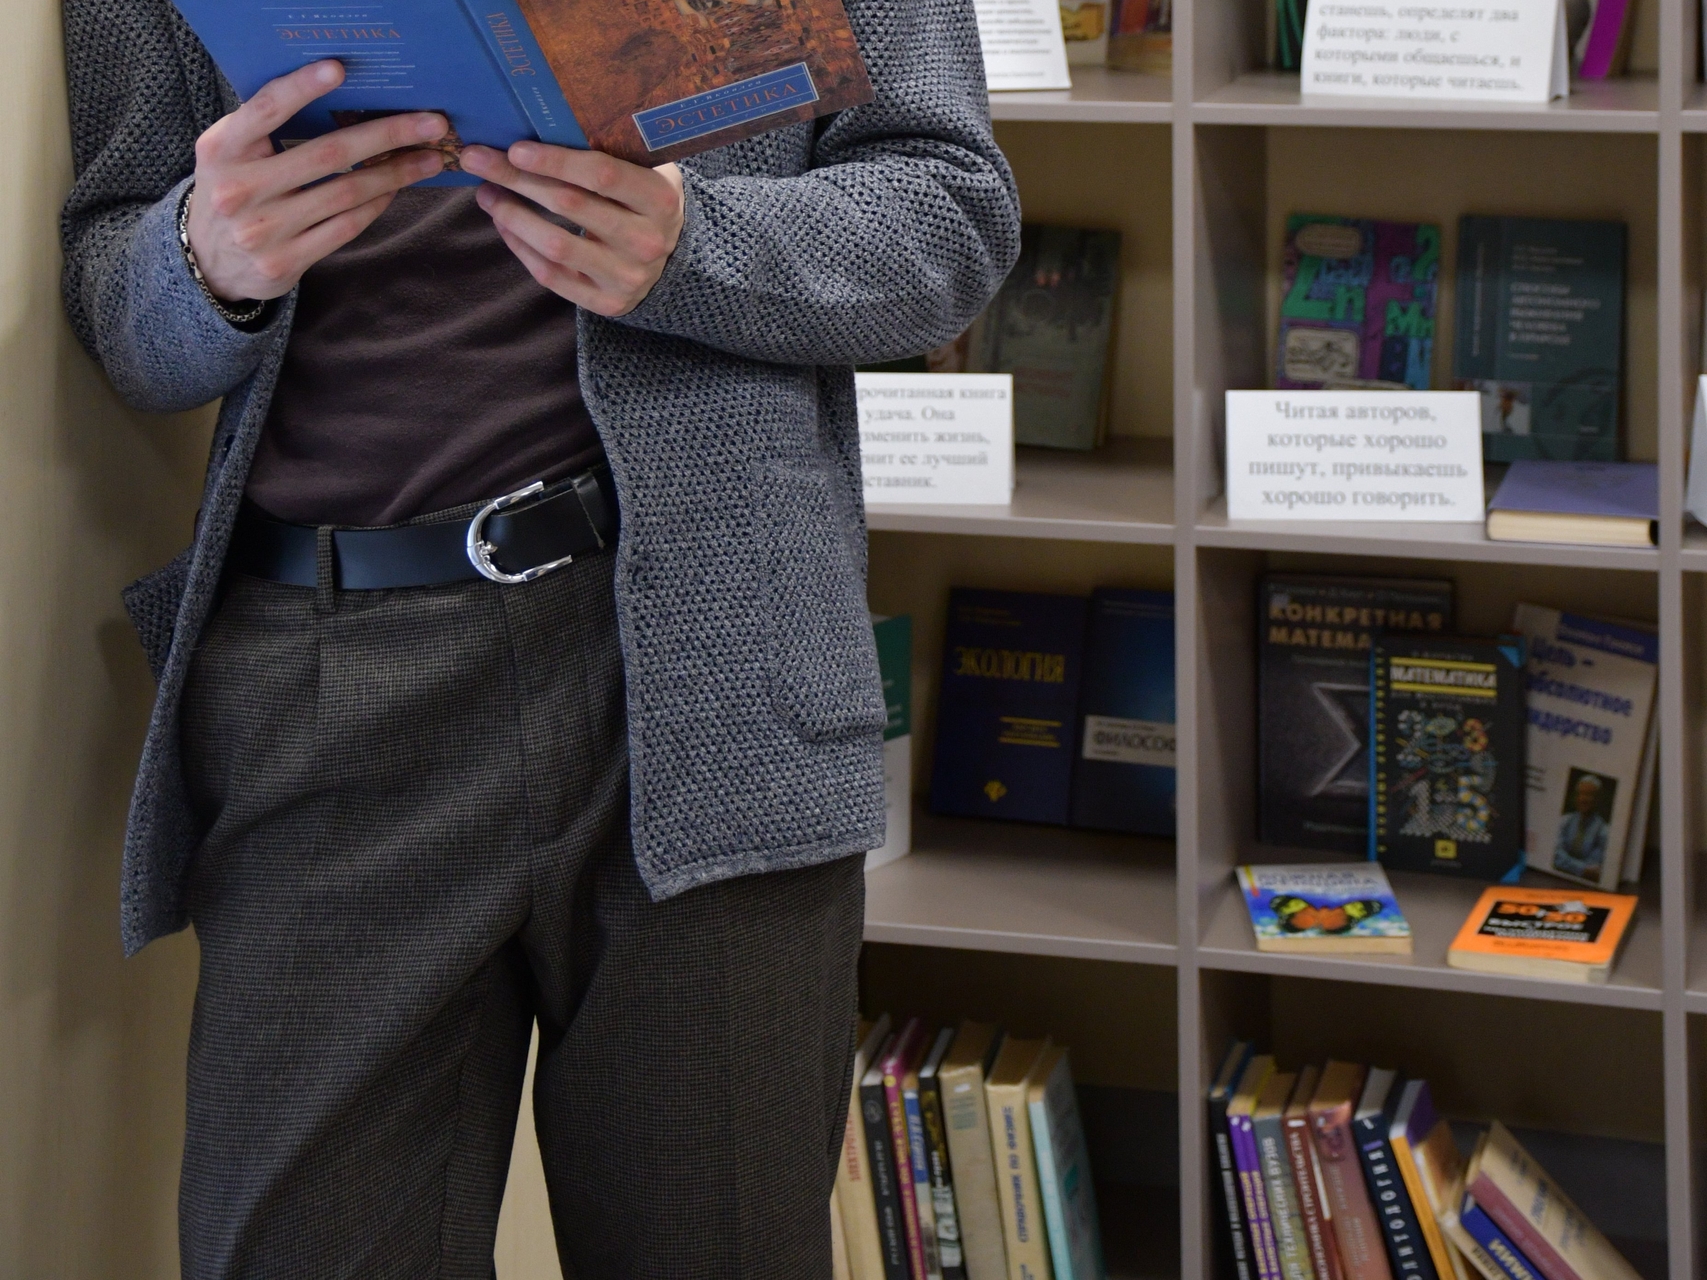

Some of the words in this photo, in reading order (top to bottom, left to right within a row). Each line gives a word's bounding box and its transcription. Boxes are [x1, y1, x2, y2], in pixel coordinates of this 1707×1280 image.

[1319, 5, 1393, 19] станешь,
[1398, 7, 1484, 21] определят
[1488, 10, 1519, 23] два
[276, 27, 402, 41] ЭСТЕТИКА
[1450, 31, 1460, 42] с
[486, 12, 536, 78] ЭСТЕТИКА
[1314, 49, 1398, 65] которыми
[1403, 48, 1505, 67] общаешься,
[1509, 55, 1521, 68] и
[1372, 73, 1442, 90] которые
[655, 82, 799, 135] ЭСТЕТИКА
[857, 387, 954, 402] рочитанная
[959, 388, 1007, 400] книга
[865, 408, 915, 424] удача.
[921, 406, 956, 421] Она
[1275, 401, 1339, 419] Читая
[1345, 404, 1437, 424] авторов,
[859, 431, 930, 443] зменить
[934, 431, 991, 445] жизнь,
[1267, 432, 1357, 452] которые
[1363, 433, 1448, 453] хорошо
[861, 453, 894, 465] нит
[921, 450, 989, 468] лучший
[1248, 460, 1326, 480] пишут,
[1332, 461, 1468, 481] привыкаешь
[1262, 489, 1347, 509] хорошо
[1352, 490, 1456, 510] говорить.
[1268, 625, 1372, 650] МАТЕМА
[1389, 666, 1498, 688] МАТЕМАТИКА
[1527, 707, 1613, 745] идерство
[1262, 1136, 1281, 1178] ВУЗОВ
[1368, 1149, 1424, 1280] ЛИТОЛОГИЯ
[1307, 1214, 1330, 1280] КОНОМИКА
[1287, 1260, 1303, 1280] ЛЯ
